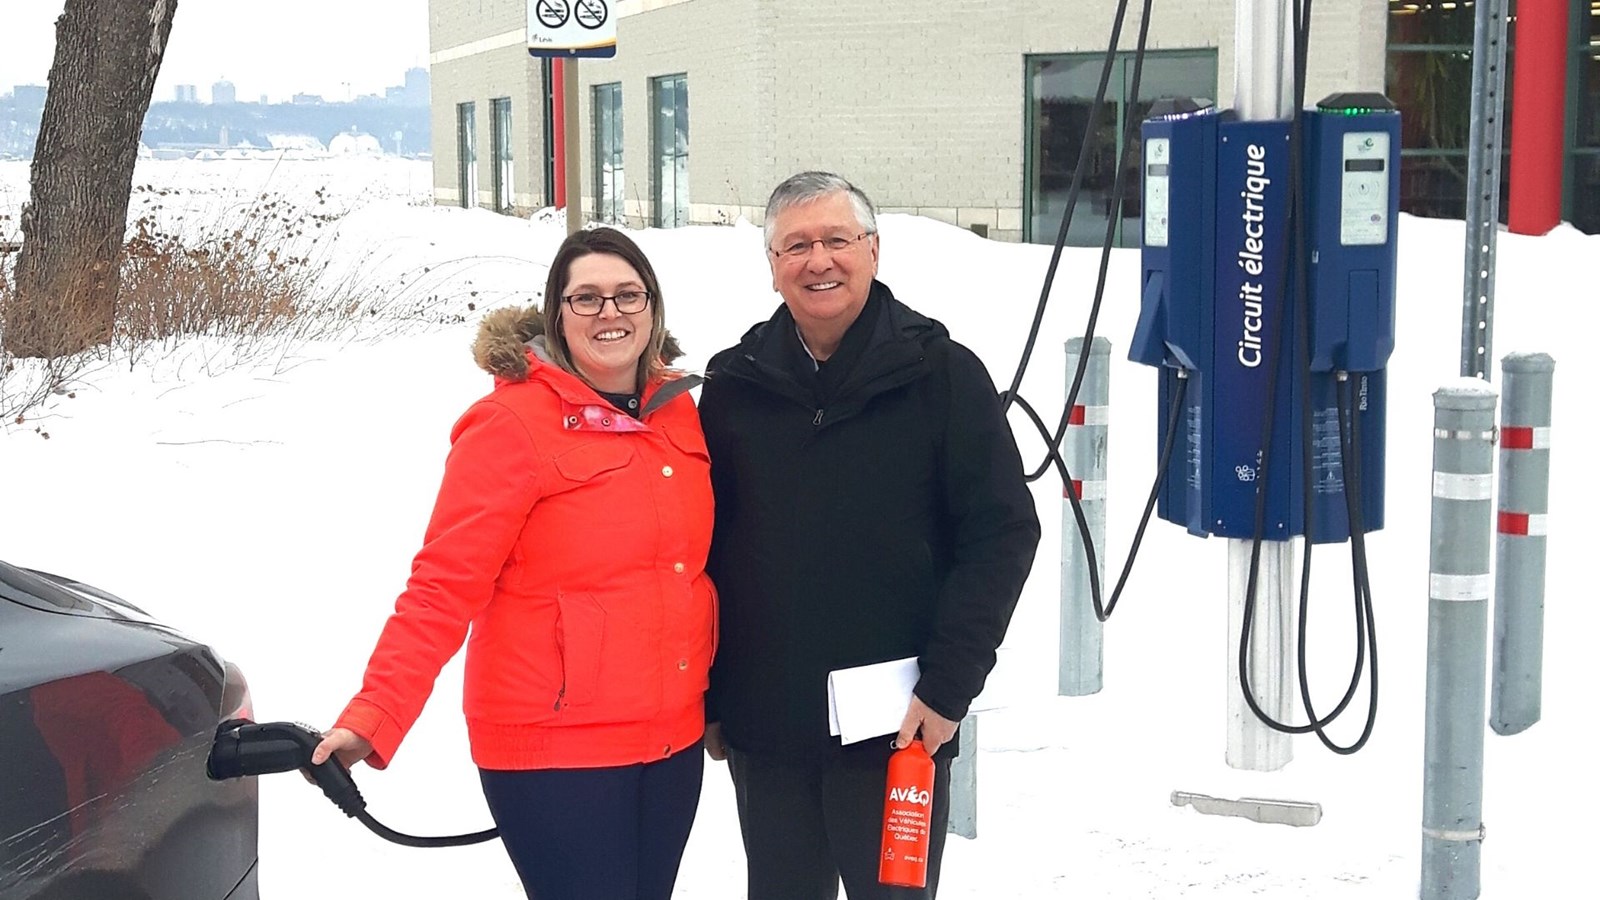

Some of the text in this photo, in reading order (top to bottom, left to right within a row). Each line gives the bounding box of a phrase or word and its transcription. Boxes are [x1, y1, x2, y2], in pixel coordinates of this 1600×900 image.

[1237, 144, 1270, 367] Circuit électrique
[892, 809, 924, 818] Association
